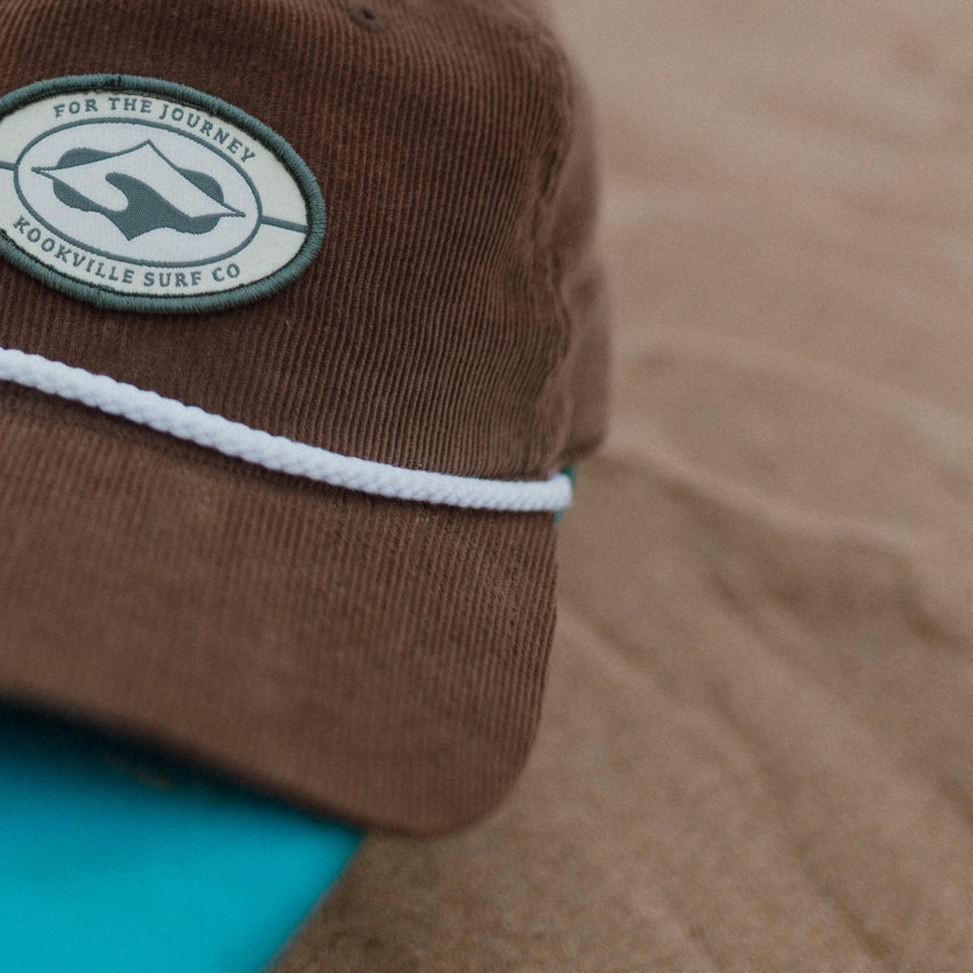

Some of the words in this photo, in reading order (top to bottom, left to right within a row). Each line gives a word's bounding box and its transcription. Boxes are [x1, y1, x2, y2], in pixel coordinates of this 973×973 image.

[53, 98, 98, 119] FOR
[108, 97, 152, 114] THE
[159, 103, 257, 165] JOURNEY
[12, 215, 135, 285] KOOKVILLE
[143, 270, 202, 288] SURF
[211, 263, 241, 283] CO
